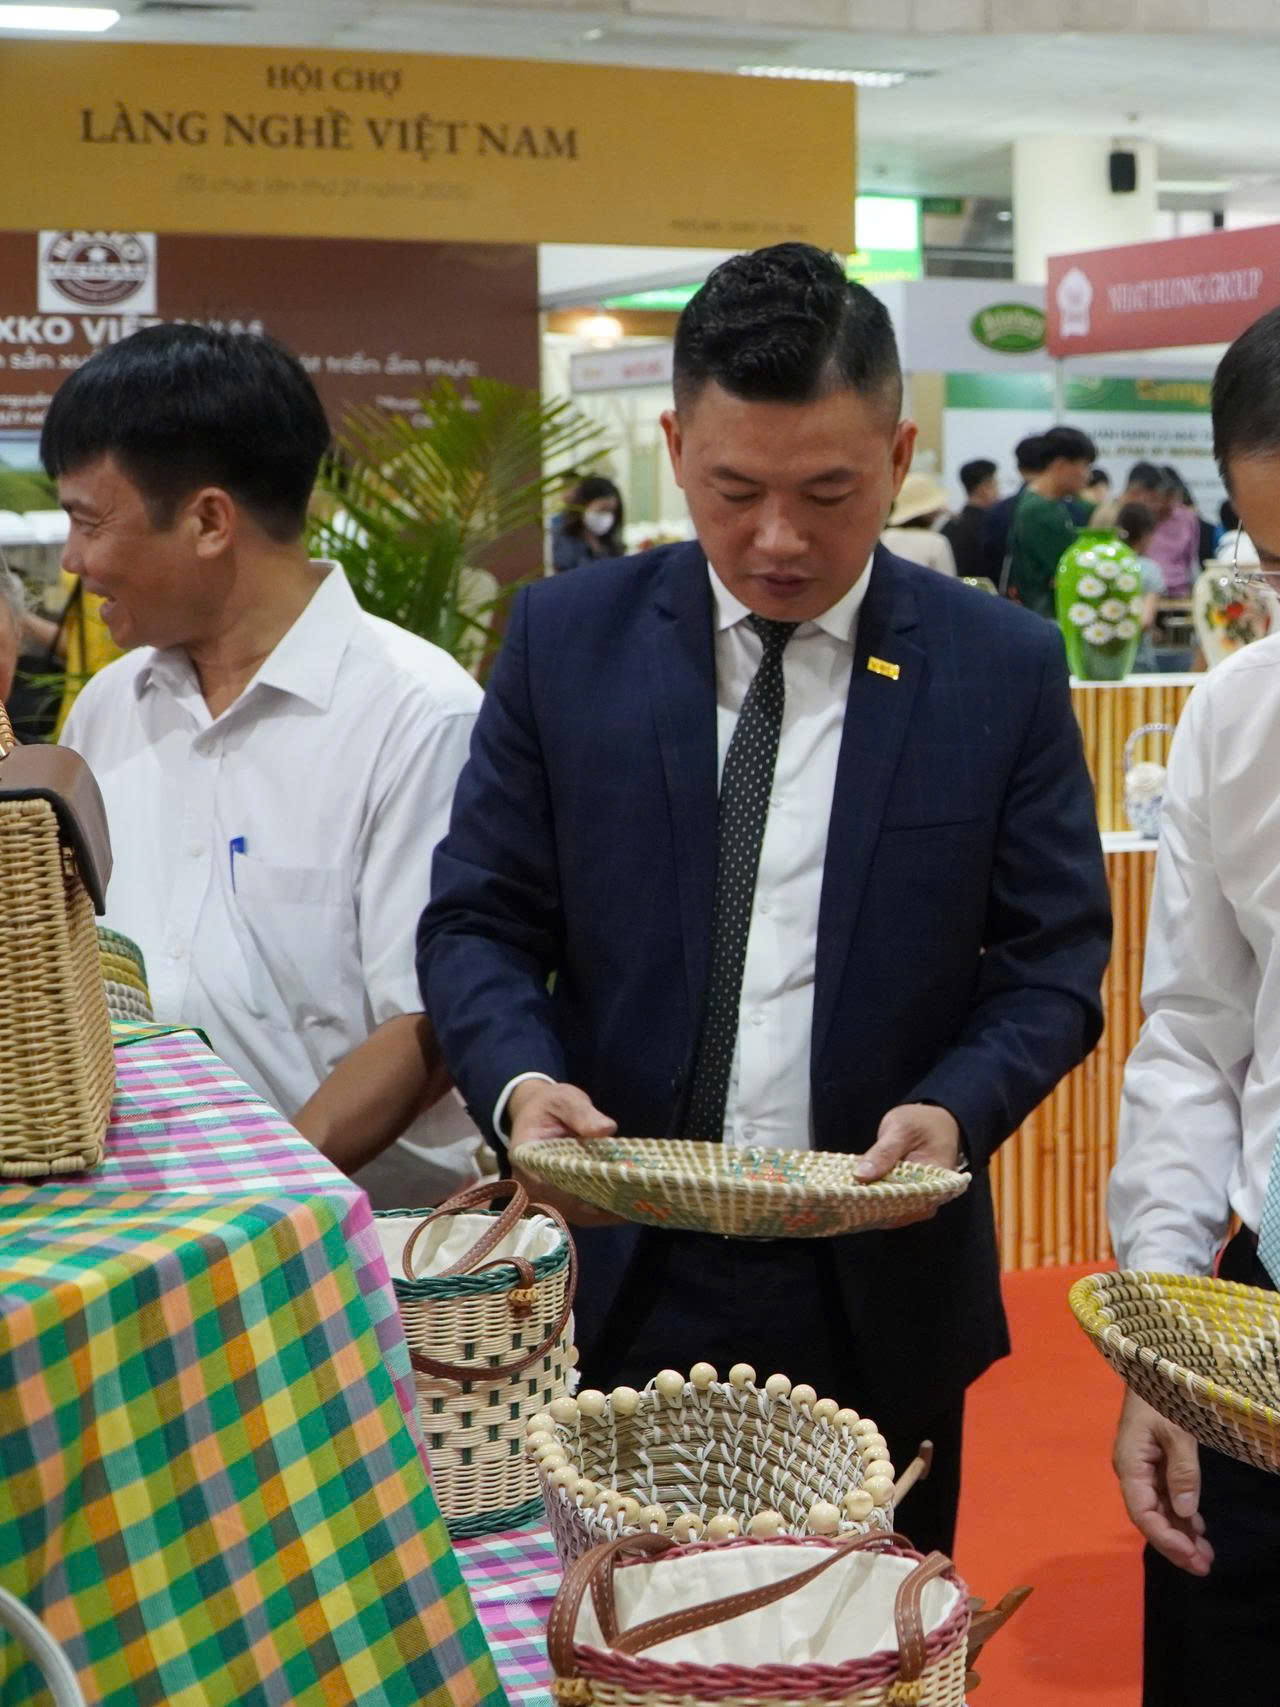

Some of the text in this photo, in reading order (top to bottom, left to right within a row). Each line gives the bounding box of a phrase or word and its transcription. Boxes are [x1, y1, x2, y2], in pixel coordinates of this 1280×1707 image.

[266, 61, 402, 99] HỘI CHỢ
[81, 102, 580, 162] LÀNG NGHỀ VIỆT NAM
